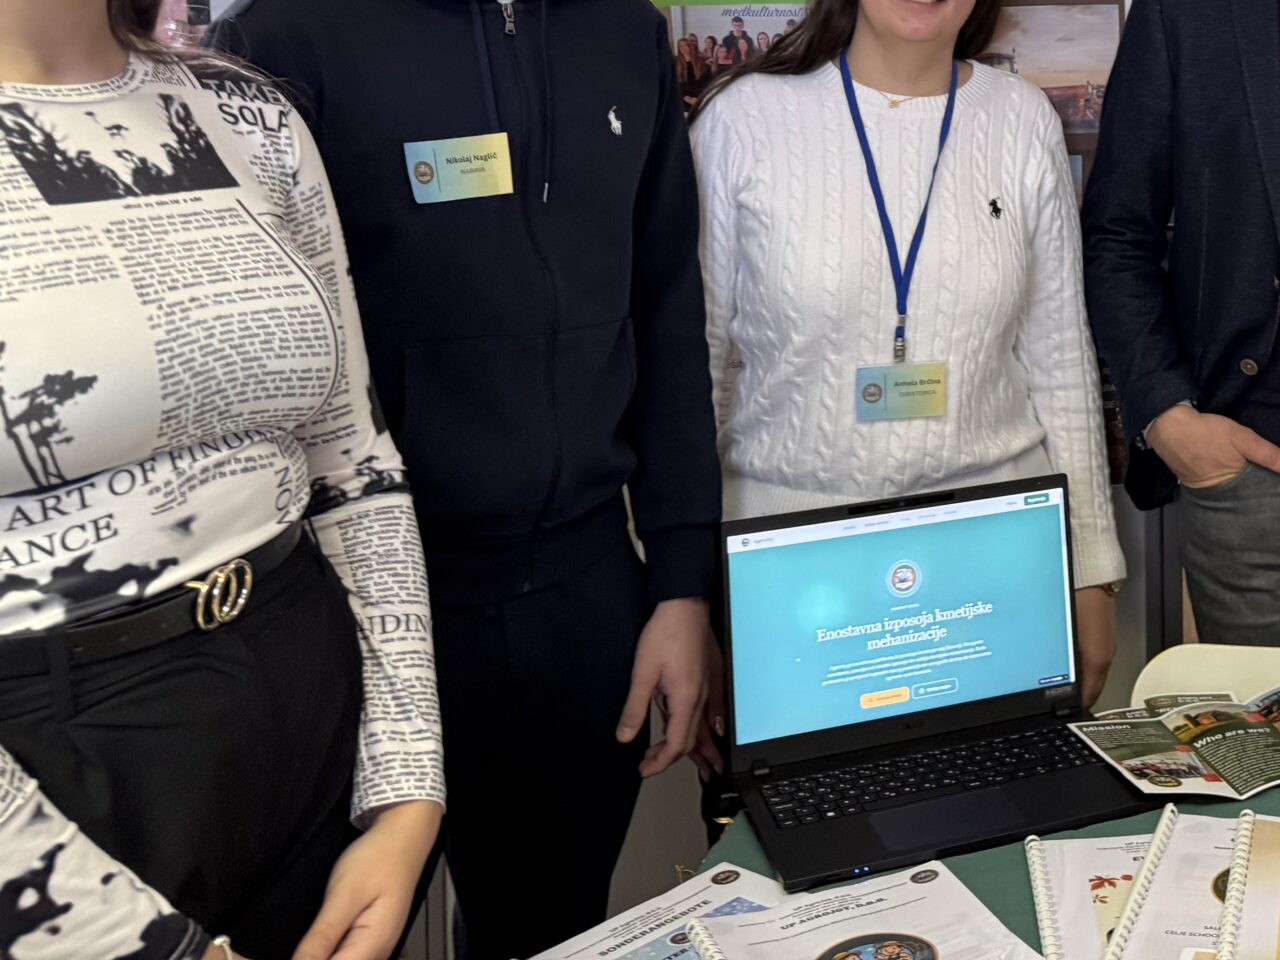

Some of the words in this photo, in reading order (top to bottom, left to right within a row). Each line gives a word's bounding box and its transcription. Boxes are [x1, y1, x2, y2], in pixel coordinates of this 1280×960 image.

[202, 78, 283, 106] TAKE
[4, 480, 97, 531] ART
[107, 458, 157, 496] OF
[816, 622, 882, 643] Enostavna
[884, 612, 933, 632] izposoja
[935, 601, 992, 623] kmetijske
[867, 626, 947, 650] mehanizacije
[1082, 724, 1131, 732] Mission
[1193, 733, 1223, 748] Who
[1224, 730, 1245, 738] are
[597, 899, 712, 957] SONDERANGEBOTE
[780, 922, 796, 930] UP
